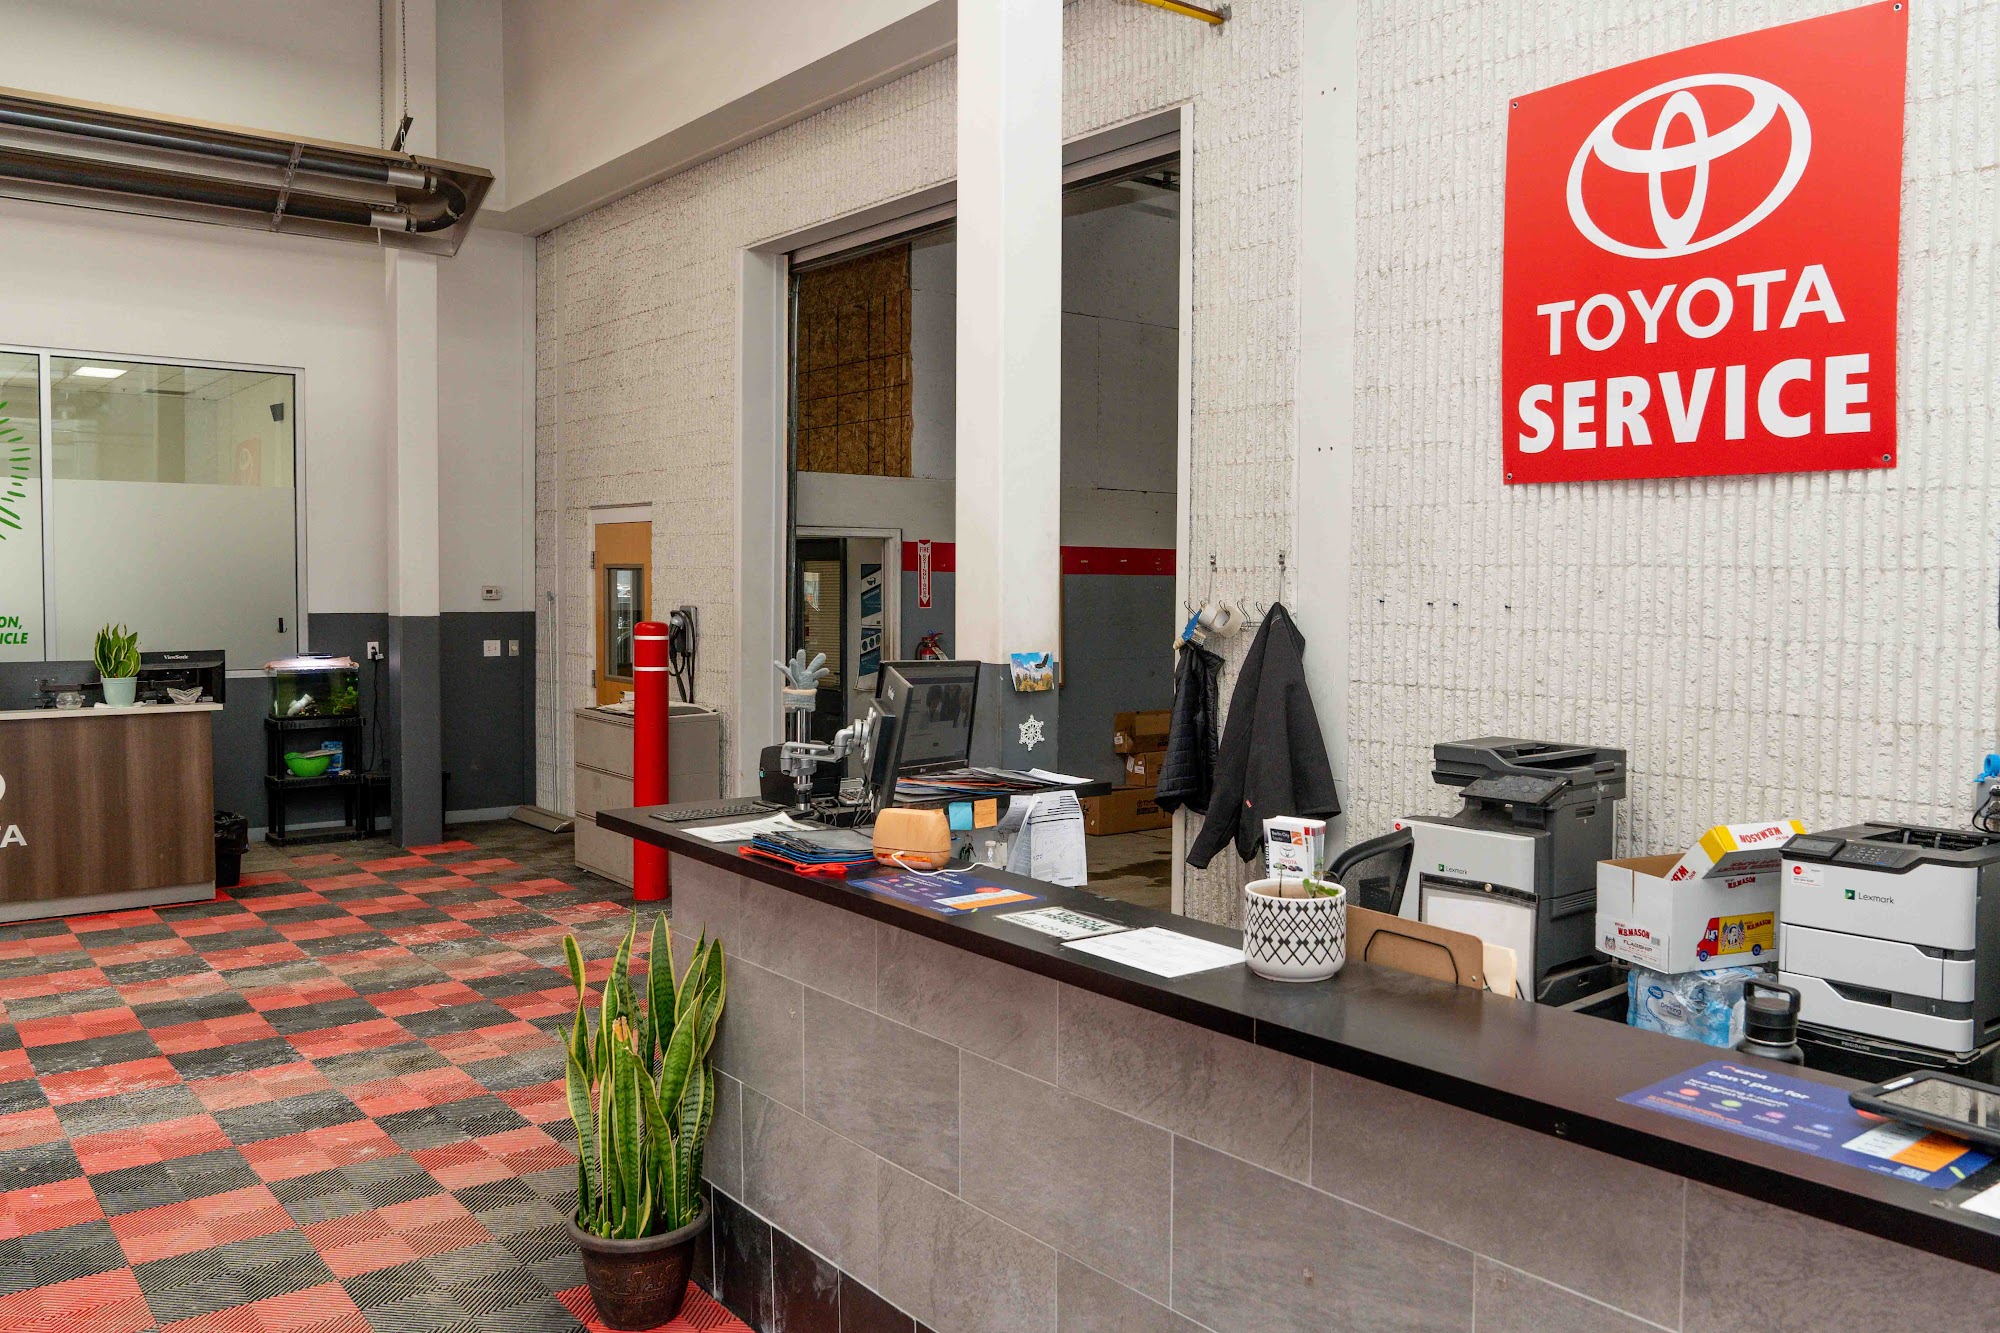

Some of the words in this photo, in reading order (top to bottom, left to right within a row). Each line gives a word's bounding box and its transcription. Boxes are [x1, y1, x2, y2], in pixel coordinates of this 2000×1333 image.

[1537, 264, 1845, 356] TOYOTA
[1518, 353, 1872, 454] SERVICE
[1446, 866, 1468, 874] Lexmark
[1858, 892, 1895, 904] Lexmark
[1618, 926, 1650, 940] W.B.MASON
[1931, 1004, 1936, 1013] 1
[1706, 1070, 1751, 1085] Don't
[1748, 1082, 1785, 1094] pay
[1784, 1090, 1810, 1100] for
